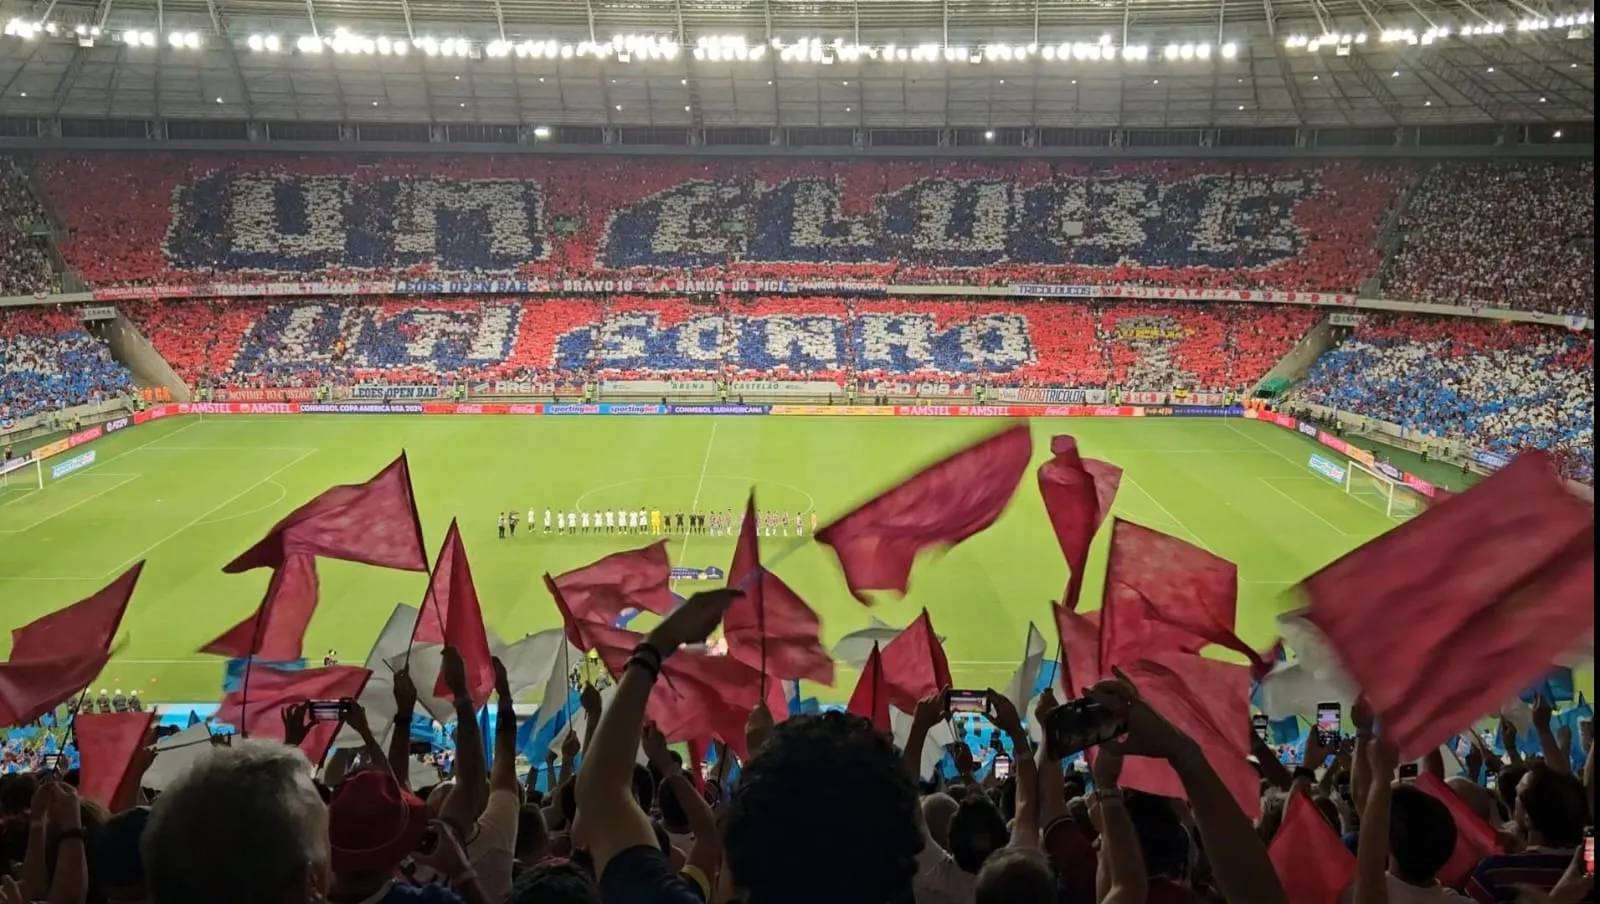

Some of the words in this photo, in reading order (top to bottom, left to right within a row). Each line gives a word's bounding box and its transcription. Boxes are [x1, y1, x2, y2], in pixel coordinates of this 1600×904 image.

[449, 281, 491, 293] OPEN
[497, 281, 529, 293] BAR
[563, 280, 613, 292] BRAVO
[386, 387, 414, 398] OPEN
[416, 387, 438, 398] BAR
[190, 403, 232, 413] AMSTEL
[251, 403, 292, 413] AMSTEL
[300, 404, 339, 412] CONMEBOL
[340, 404, 359, 412] COPA
[909, 406, 951, 415] AMSTEL
[969, 406, 1009, 415] AMSTEL
